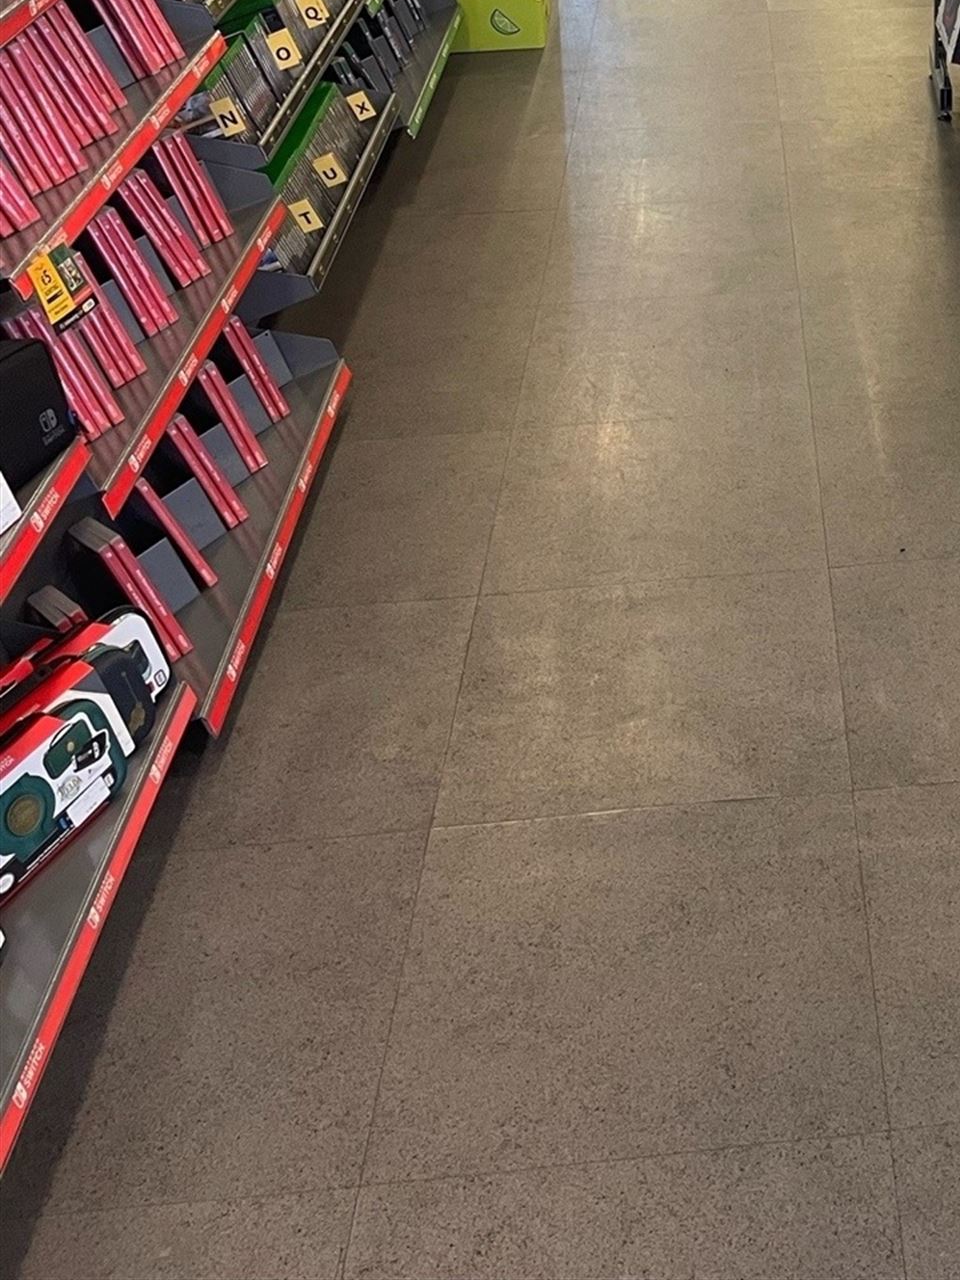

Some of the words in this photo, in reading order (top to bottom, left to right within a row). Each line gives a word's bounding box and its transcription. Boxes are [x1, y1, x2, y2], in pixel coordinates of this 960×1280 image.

[305, 6, 321, 21] Q
[276, 46, 291, 62] O
[356, 102, 370, 114] X
[220, 111, 237, 128] N
[324, 167, 337, 180] U
[298, 211, 312, 225] T
